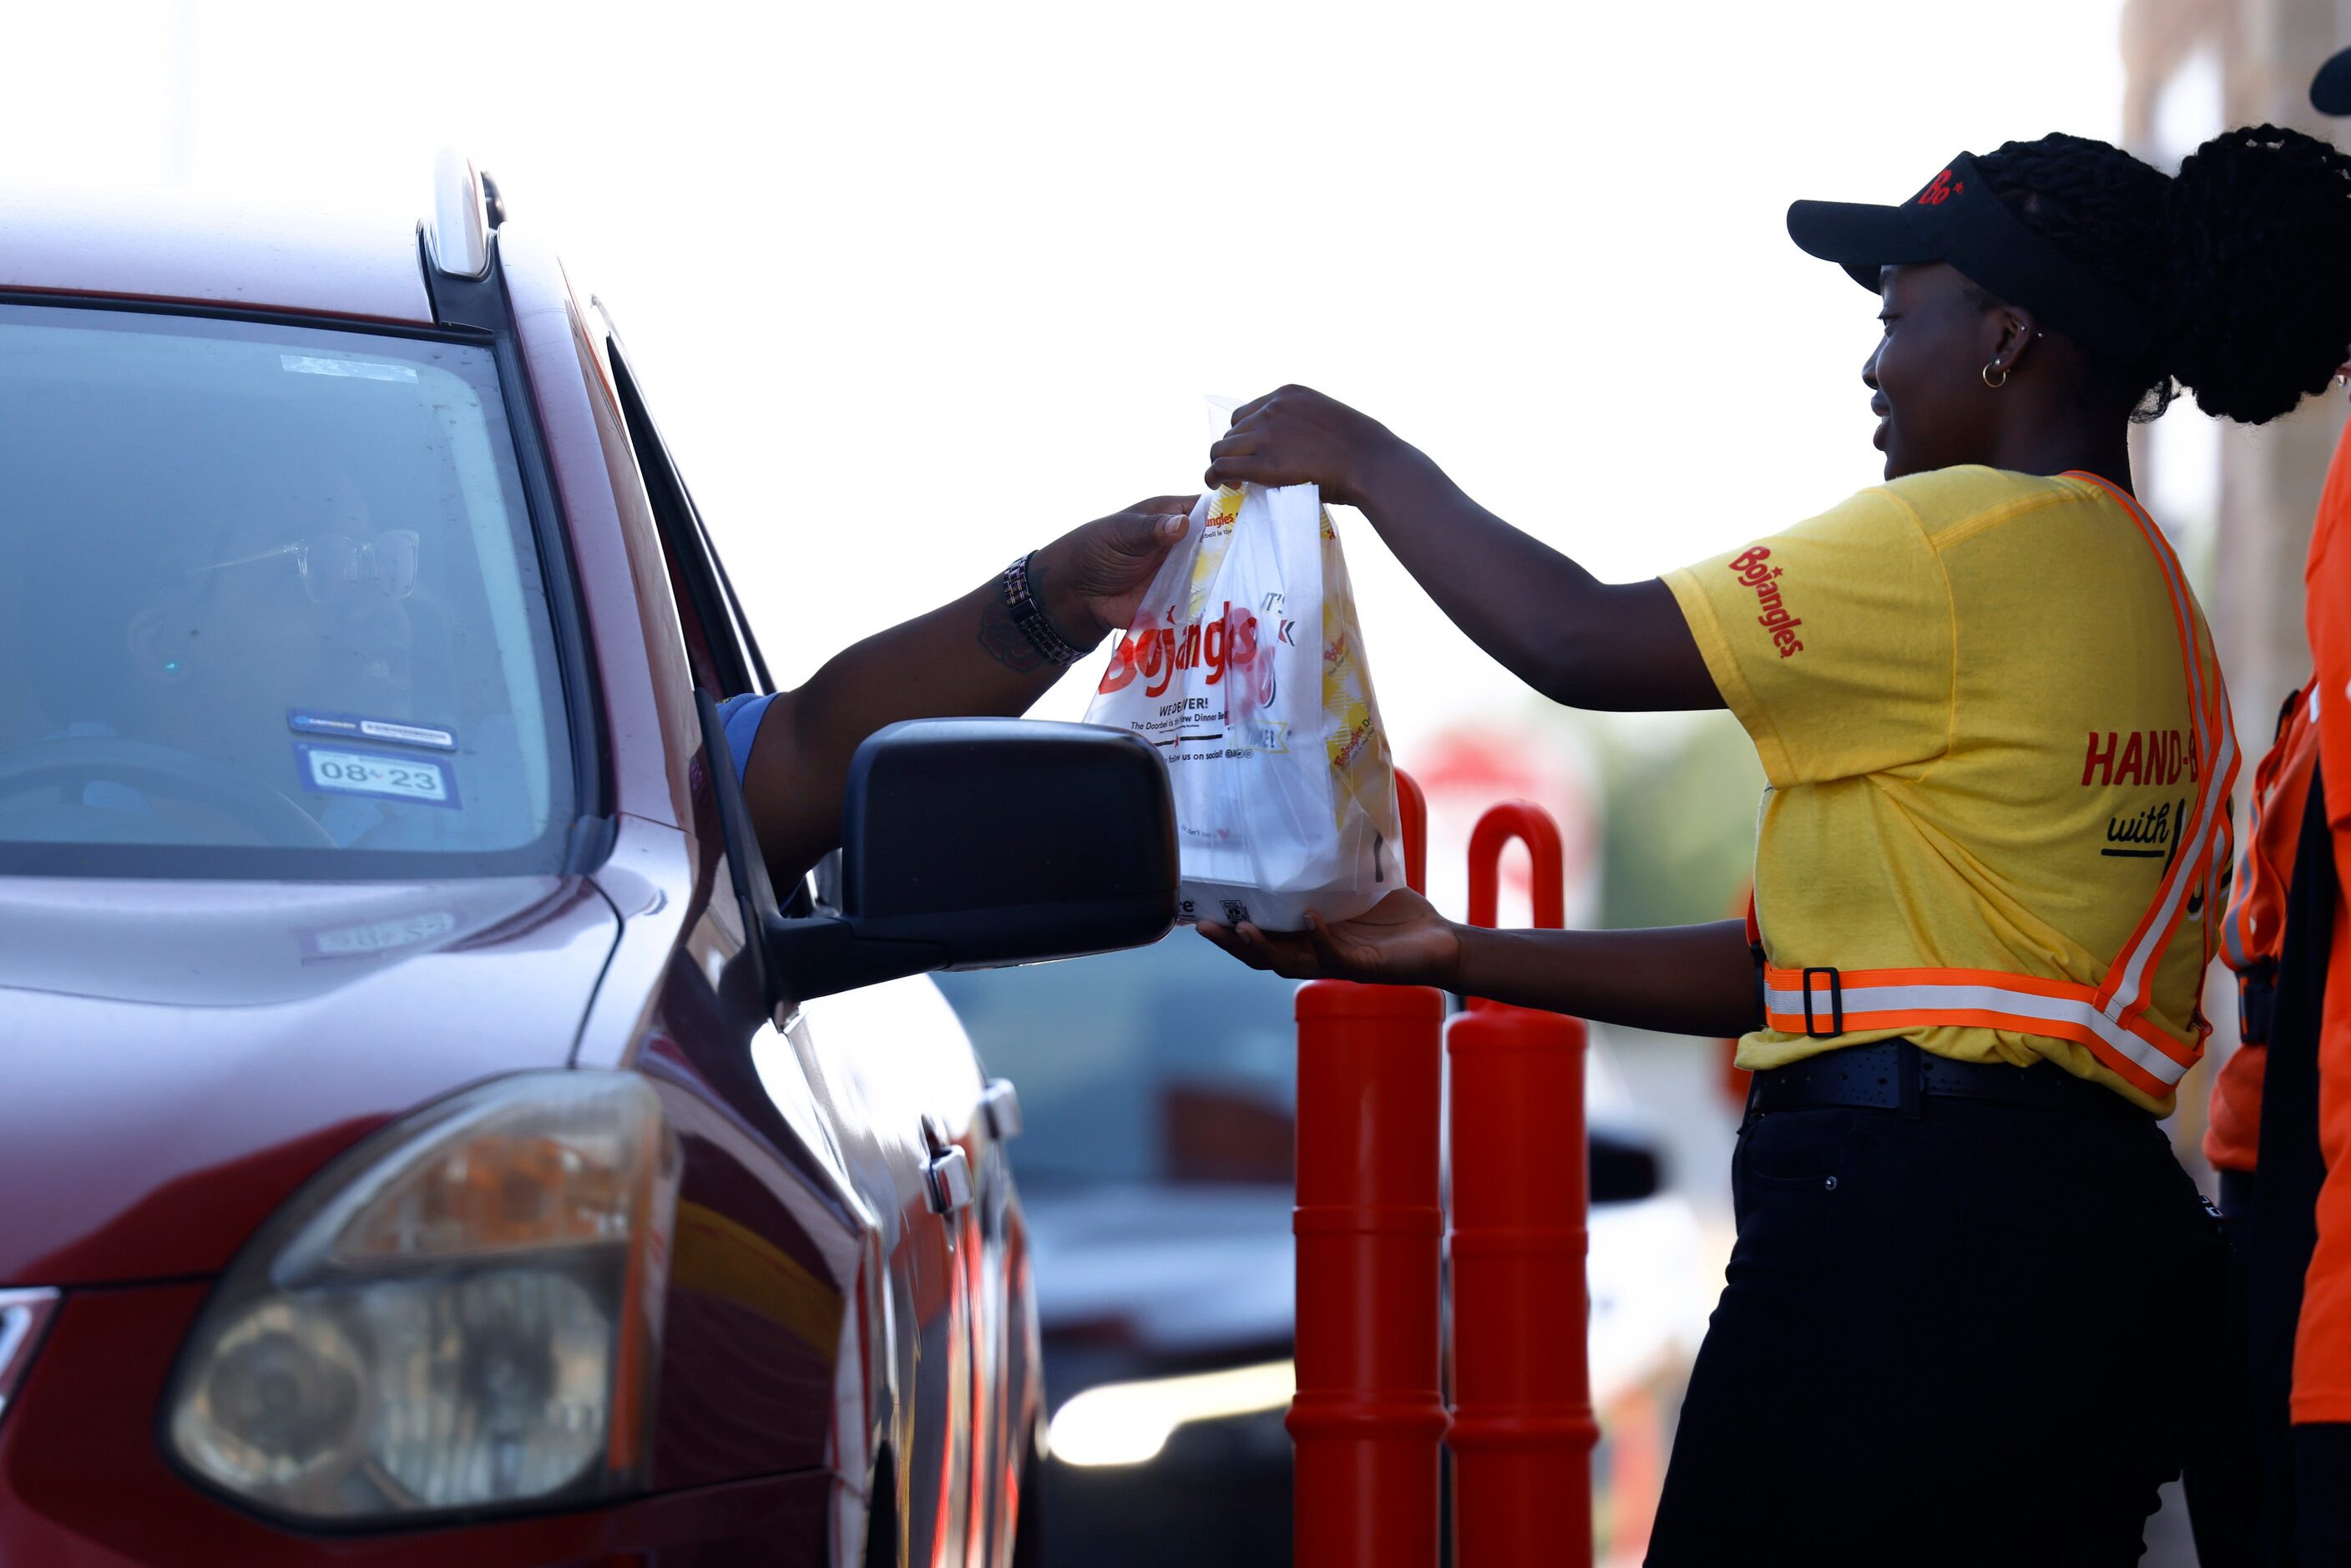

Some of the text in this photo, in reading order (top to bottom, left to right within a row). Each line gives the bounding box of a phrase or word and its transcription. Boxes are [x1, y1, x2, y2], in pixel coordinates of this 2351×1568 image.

[1918, 169, 1952, 205] Bo
[1205, 513, 1234, 529] angles
[1728, 546, 1803, 659] Bojangles
[1131, 721, 1144, 731] The
[1168, 718, 1174, 726] is
[1194, 713, 1216, 723] Dinner
[320, 761, 368, 781] 08
[389, 769, 437, 791] 23
[2107, 802, 2170, 844] with
